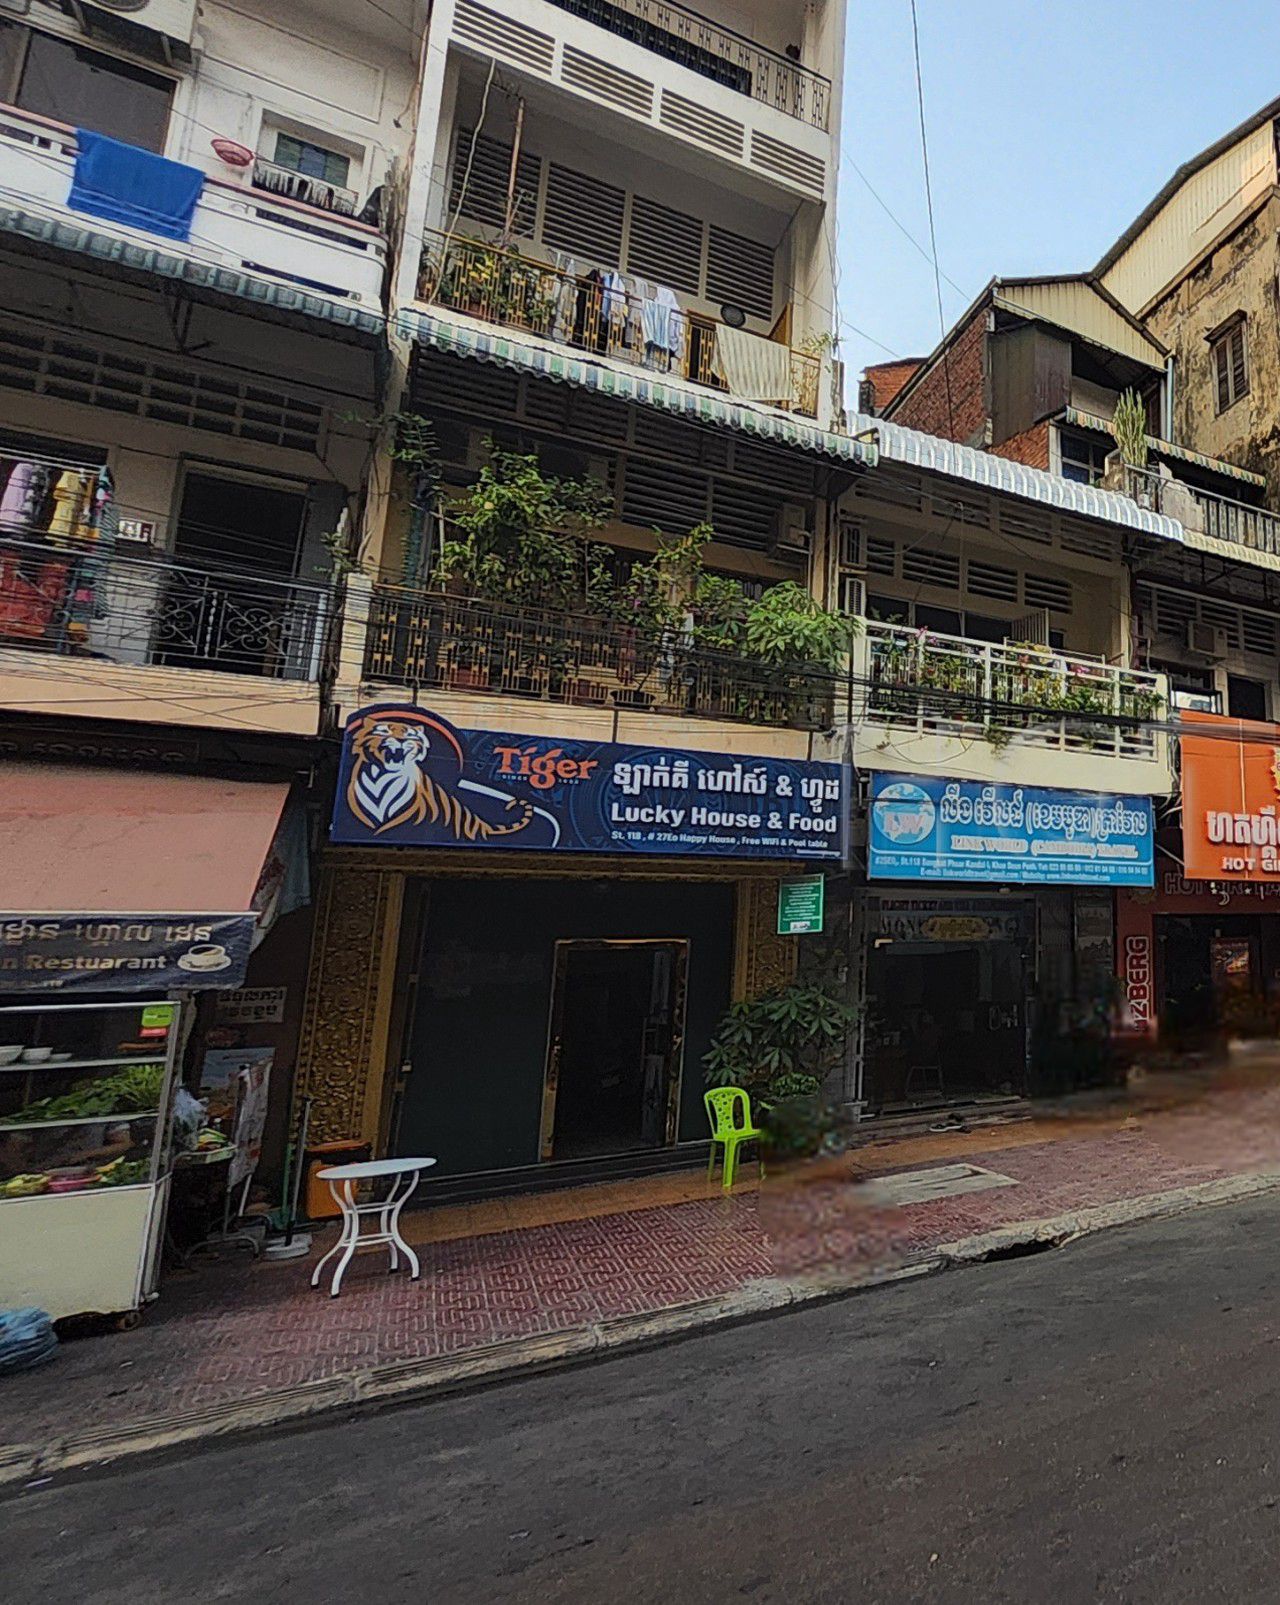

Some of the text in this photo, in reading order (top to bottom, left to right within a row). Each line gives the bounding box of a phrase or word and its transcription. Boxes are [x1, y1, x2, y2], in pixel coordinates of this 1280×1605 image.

[493, 746, 599, 789] Tiger
[775, 775, 793, 797] &
[611, 802, 838, 833] Lucky House & Food
[680, 834, 707, 844] Happy
[741, 836, 760, 845] Free
[780, 838, 787, 847] &
[1222, 857, 1256, 871] HOT
[25, 953, 167, 971] Restuarant
